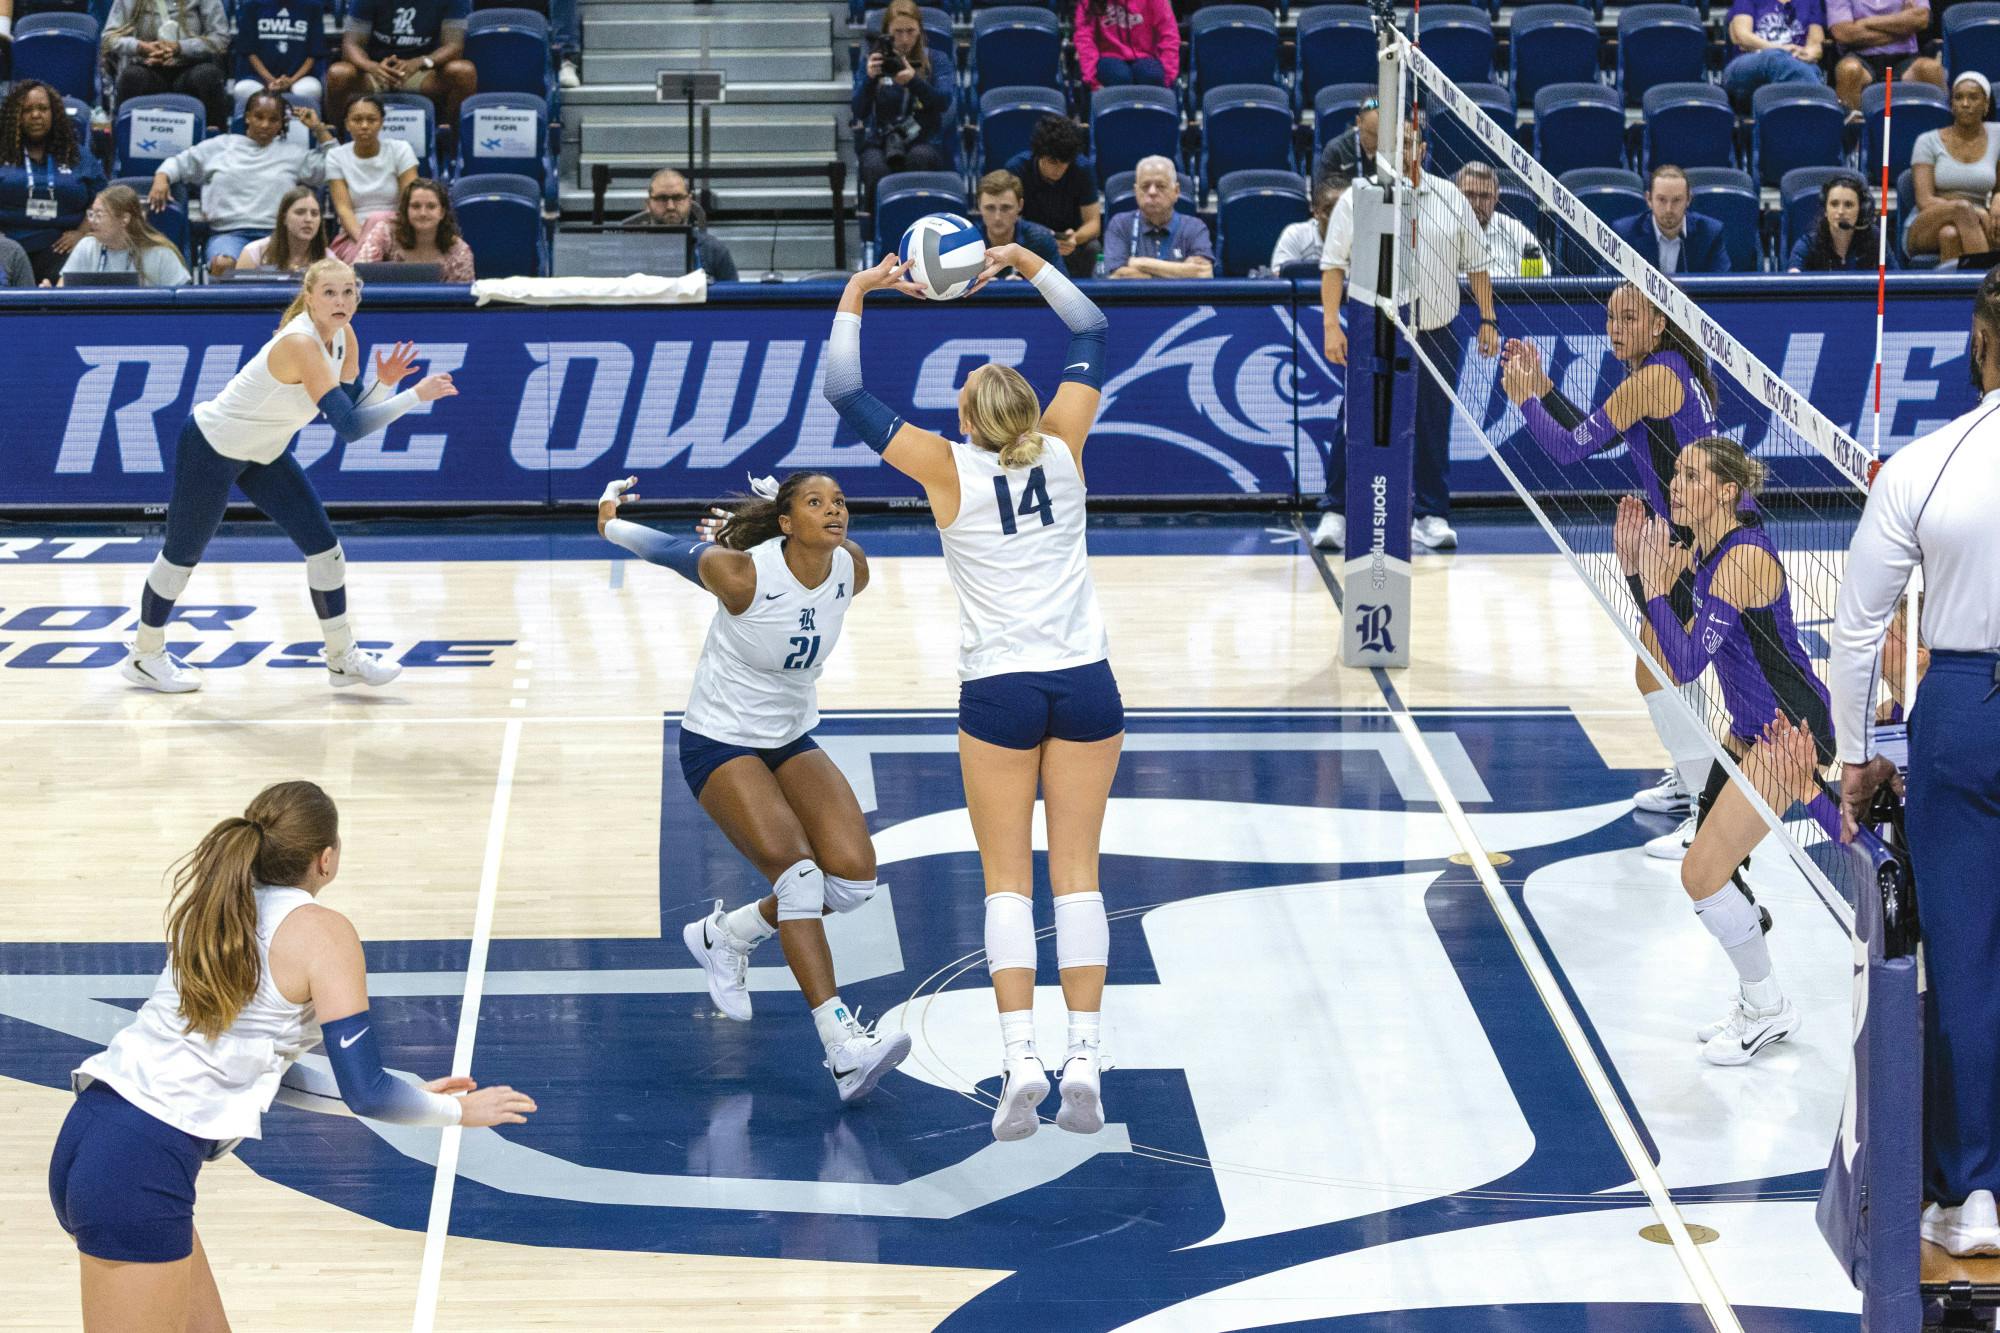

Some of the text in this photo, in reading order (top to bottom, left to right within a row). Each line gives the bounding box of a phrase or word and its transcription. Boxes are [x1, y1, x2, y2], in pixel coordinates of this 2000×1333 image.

[257, 18, 308, 34] OWLS
[137, 115, 187, 124] RESERVED
[150, 125, 175, 134] FOR
[493, 124, 518, 132] FOR
[993, 464, 1054, 535] 14
[1370, 475, 1387, 590] sports imports
[799, 607, 816, 631] R
[1356, 603, 1396, 654] R
[783, 635, 821, 669] 21
